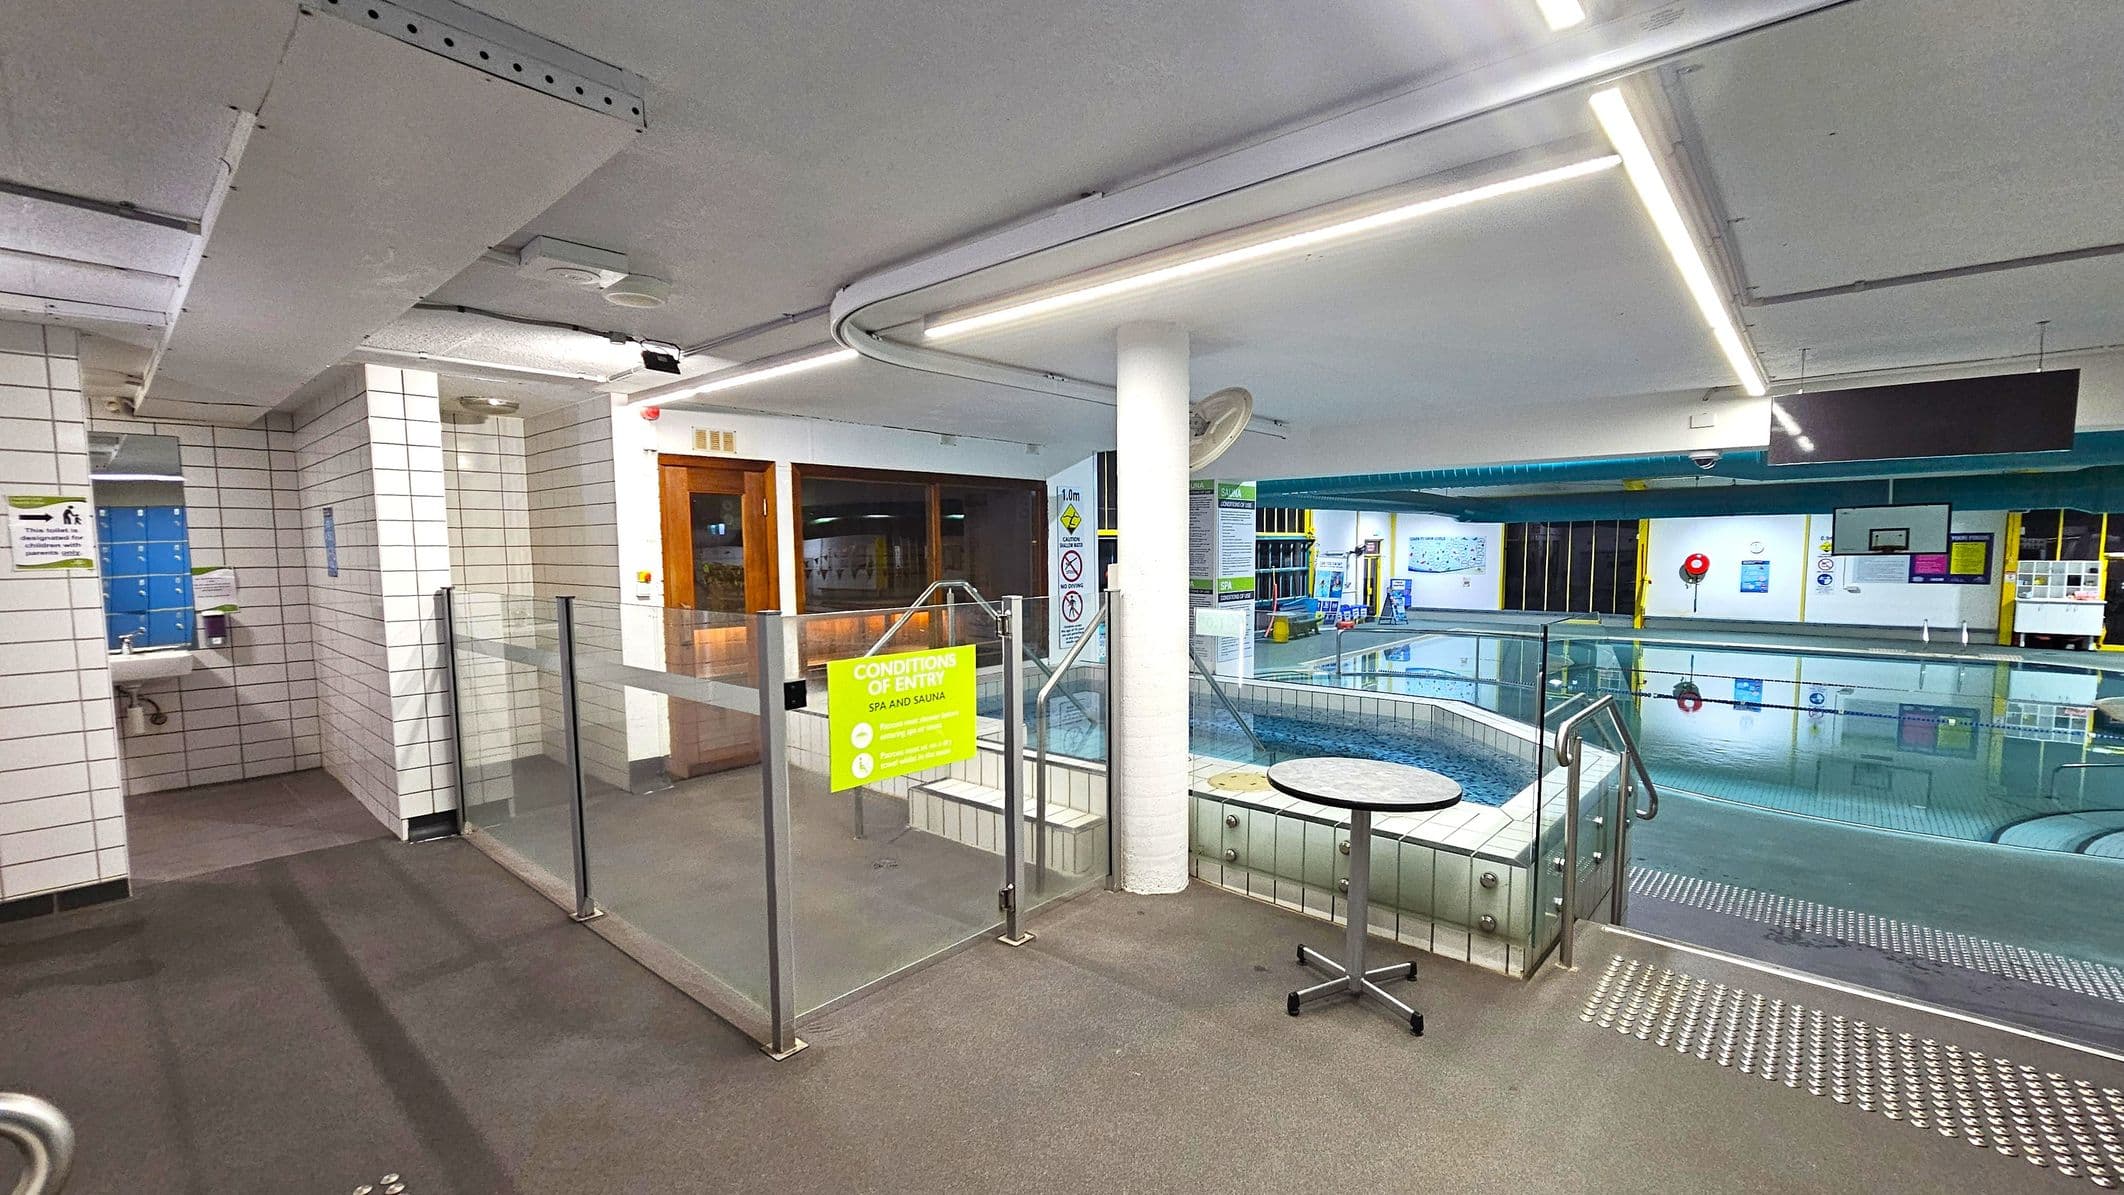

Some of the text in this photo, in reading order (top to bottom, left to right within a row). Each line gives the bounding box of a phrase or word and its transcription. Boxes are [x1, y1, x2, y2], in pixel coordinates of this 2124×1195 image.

[1062, 488, 1080, 501] 1.0m
[1220, 581, 1232, 591] SPA
[853, 653, 957, 680] CONDITIONS
[867, 670, 945, 696] OF ENTRY
[868, 691, 946, 712] SPA AND SAUNA
